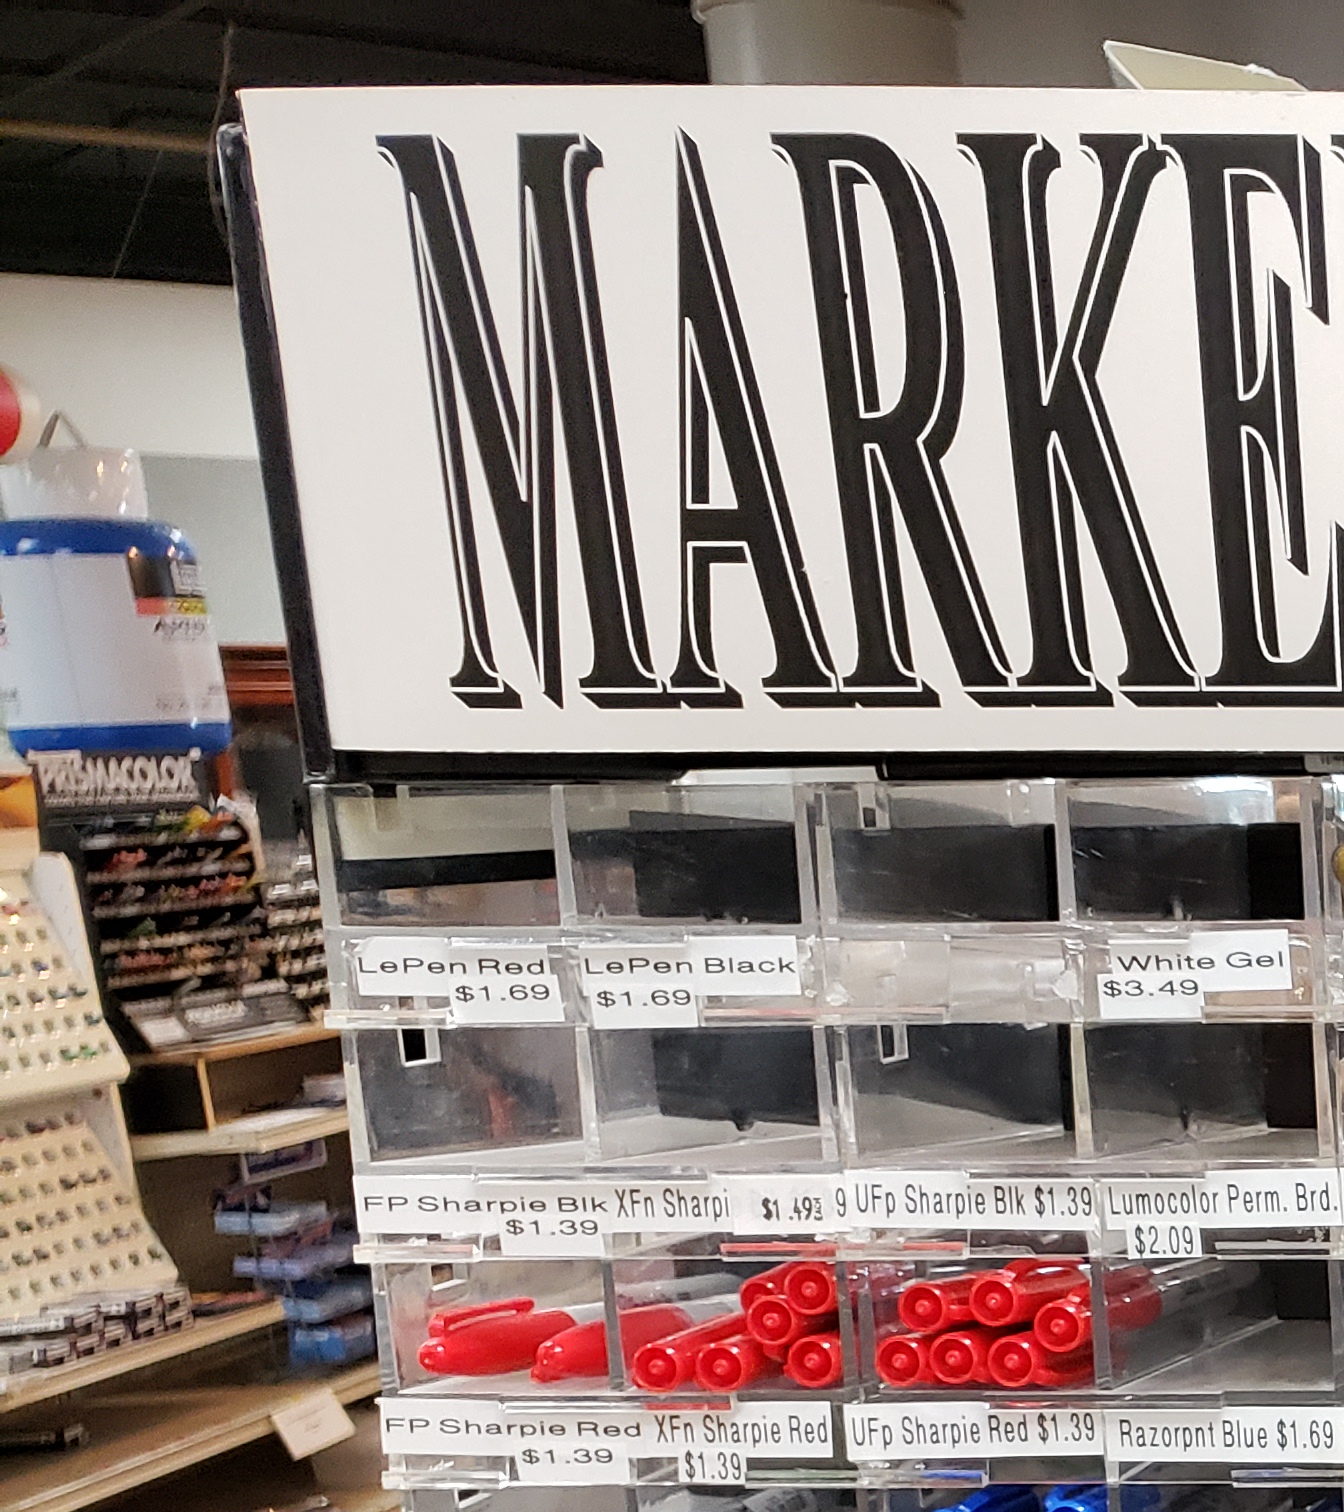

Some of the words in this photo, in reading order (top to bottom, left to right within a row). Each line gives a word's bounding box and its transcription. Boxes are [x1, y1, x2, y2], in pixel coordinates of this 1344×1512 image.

[358, 956, 466, 975] LePen
[478, 956, 546, 975] Red
[584, 956, 692, 975] LePen
[703, 956, 796, 975] Black
[1117, 953, 1214, 971] White
[1225, 950, 1284, 969] Gel
[455, 983, 551, 1003] $1.69
[597, 988, 691, 1009] $1.69
[1102, 977, 1200, 999] $3.49
[363, 1196, 408, 1212] FP
[418, 1195, 548, 1215] Sharpie
[557, 1196, 608, 1212] Blk
[1109, 1184, 1219, 1216] Lumocolor
[1226, 1183, 1289, 1214] Perm.
[1296, 1182, 1339, 1212] Brd.
[505, 1218, 599, 1238] $1.39
[1134, 1227, 1194, 1256] $2.09
[654, 1415, 696, 1444] XFn
[704, 1416, 781, 1446] Sharpie
[788, 1415, 828, 1442] Red
[684, 1452, 741, 1481] $1.39
